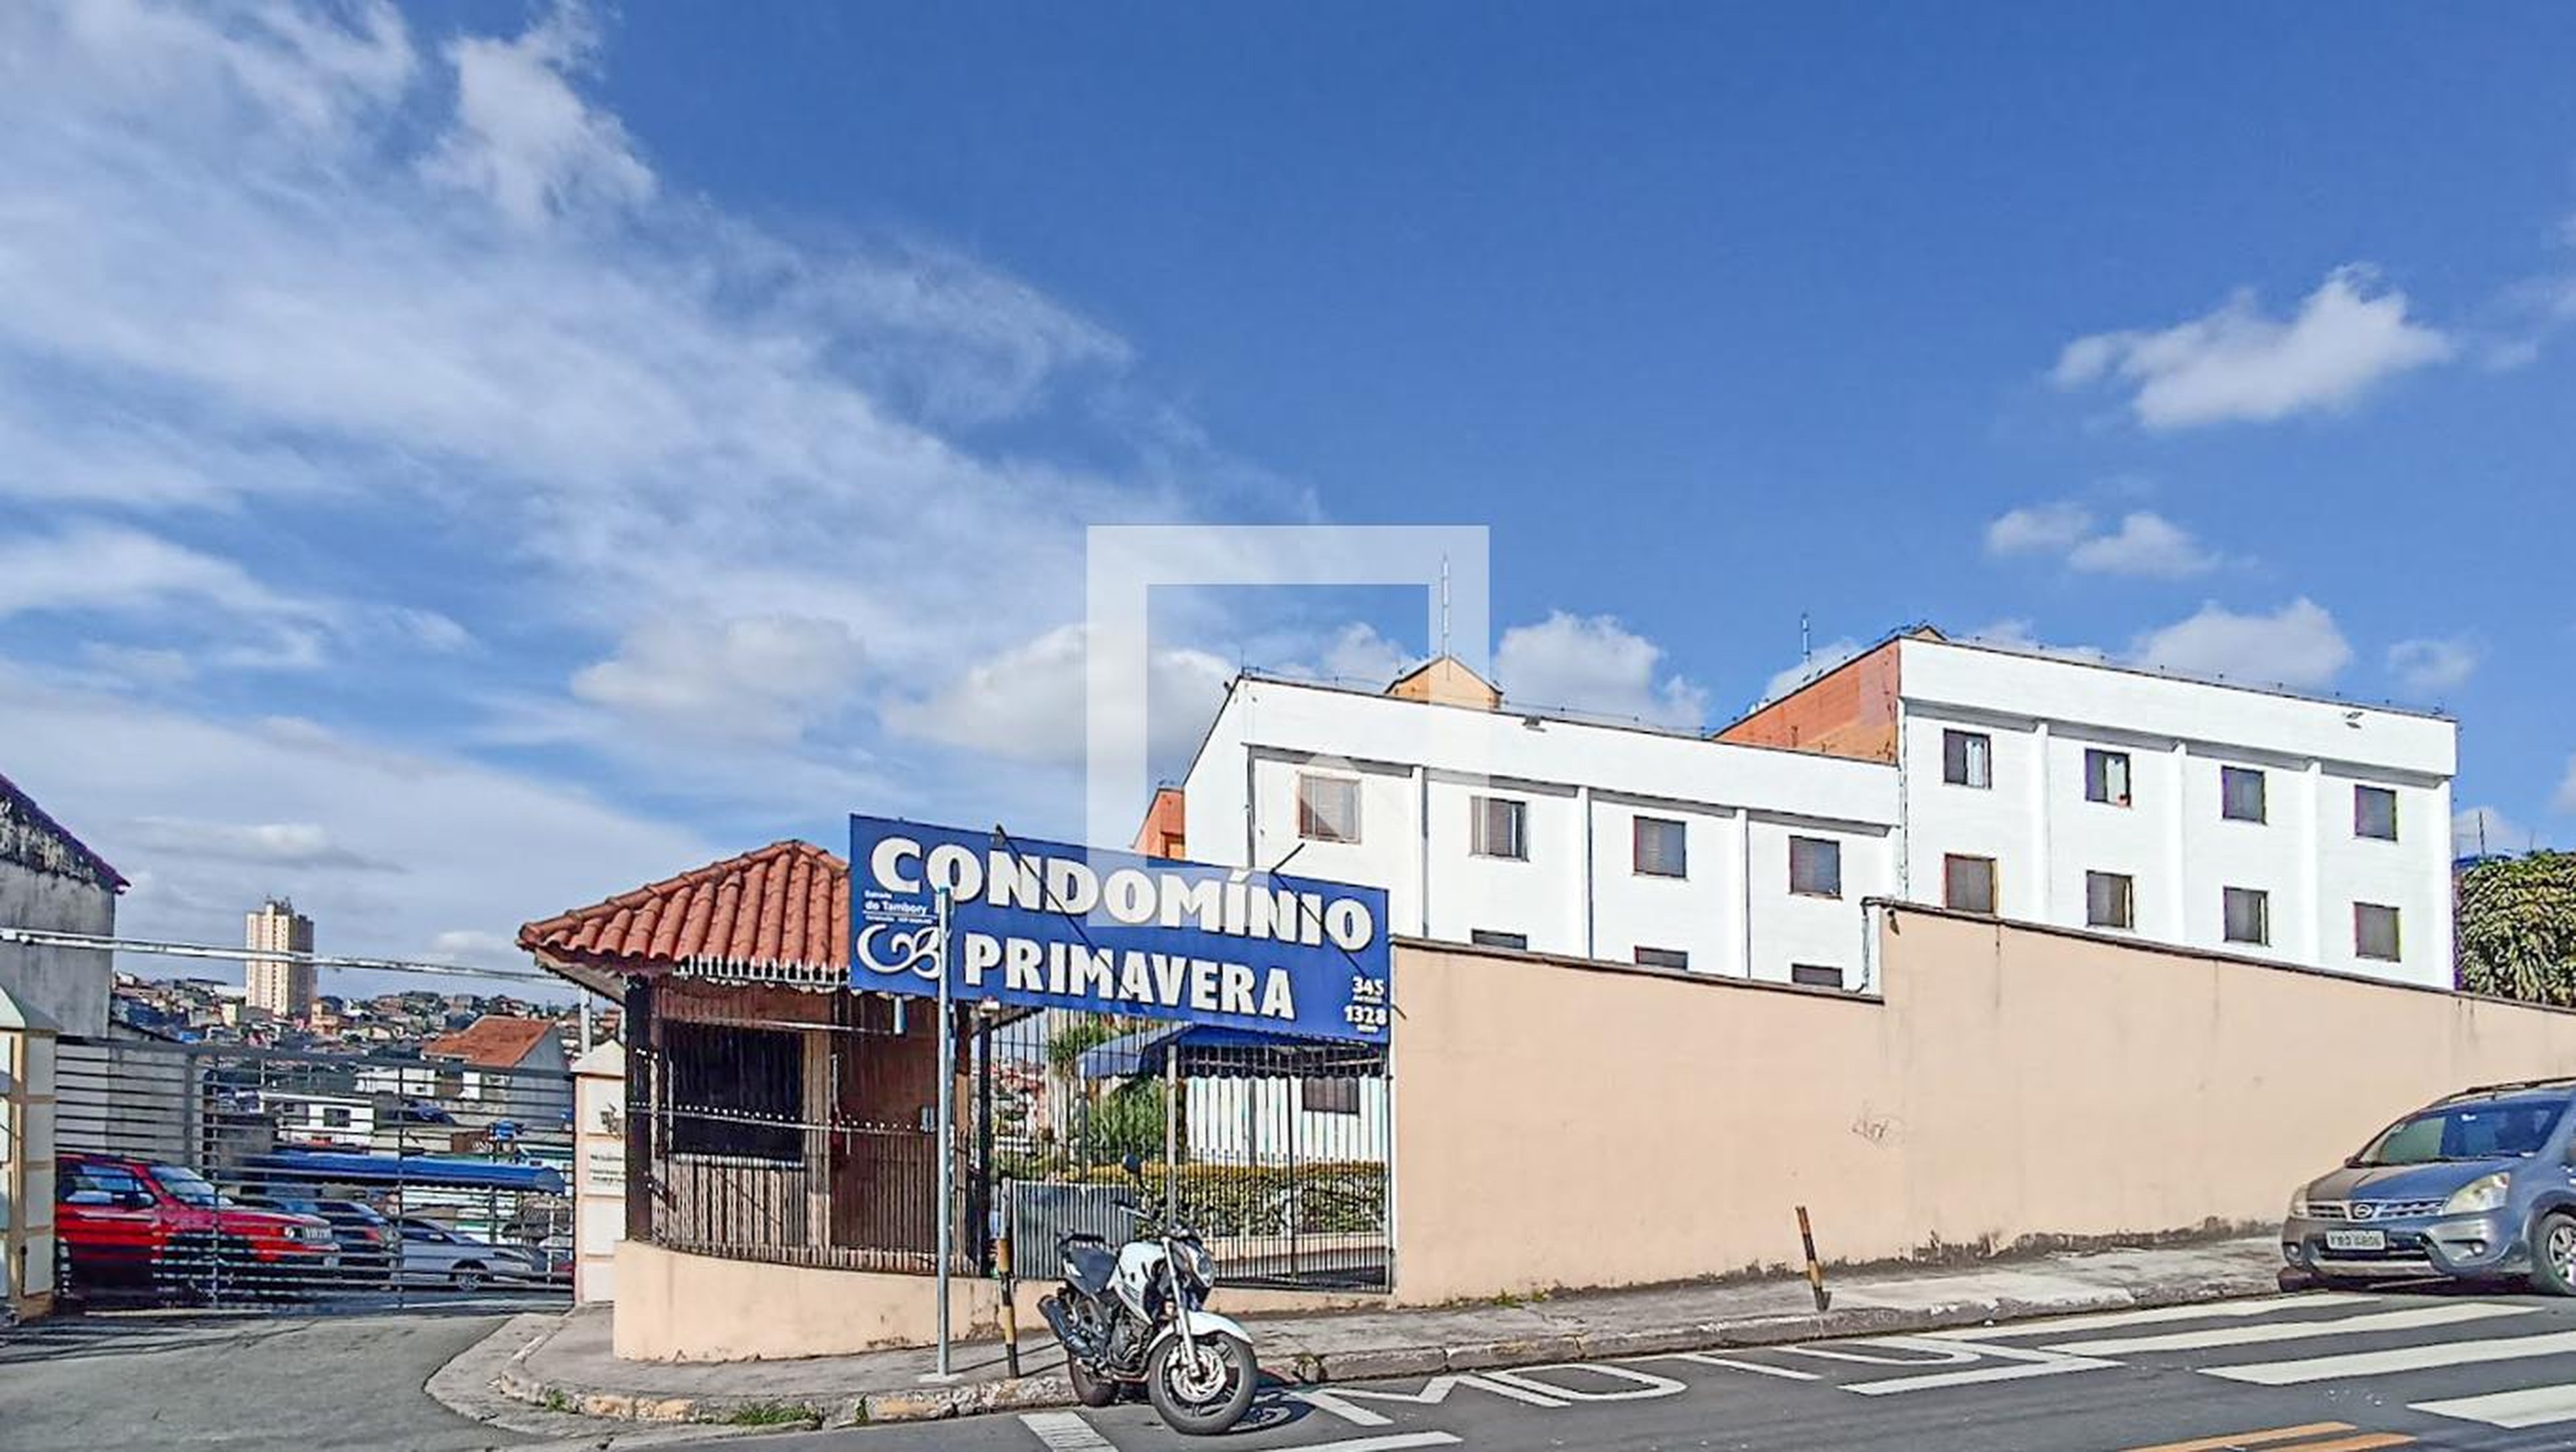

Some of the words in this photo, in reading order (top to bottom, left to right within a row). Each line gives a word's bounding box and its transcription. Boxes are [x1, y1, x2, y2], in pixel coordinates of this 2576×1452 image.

[871, 837, 1373, 951] CONDOMÍNIO
[965, 933, 1295, 1020] PRIMAVERA
[1352, 976, 1385, 996] 345
[1344, 1005, 1387, 1025] 1328
